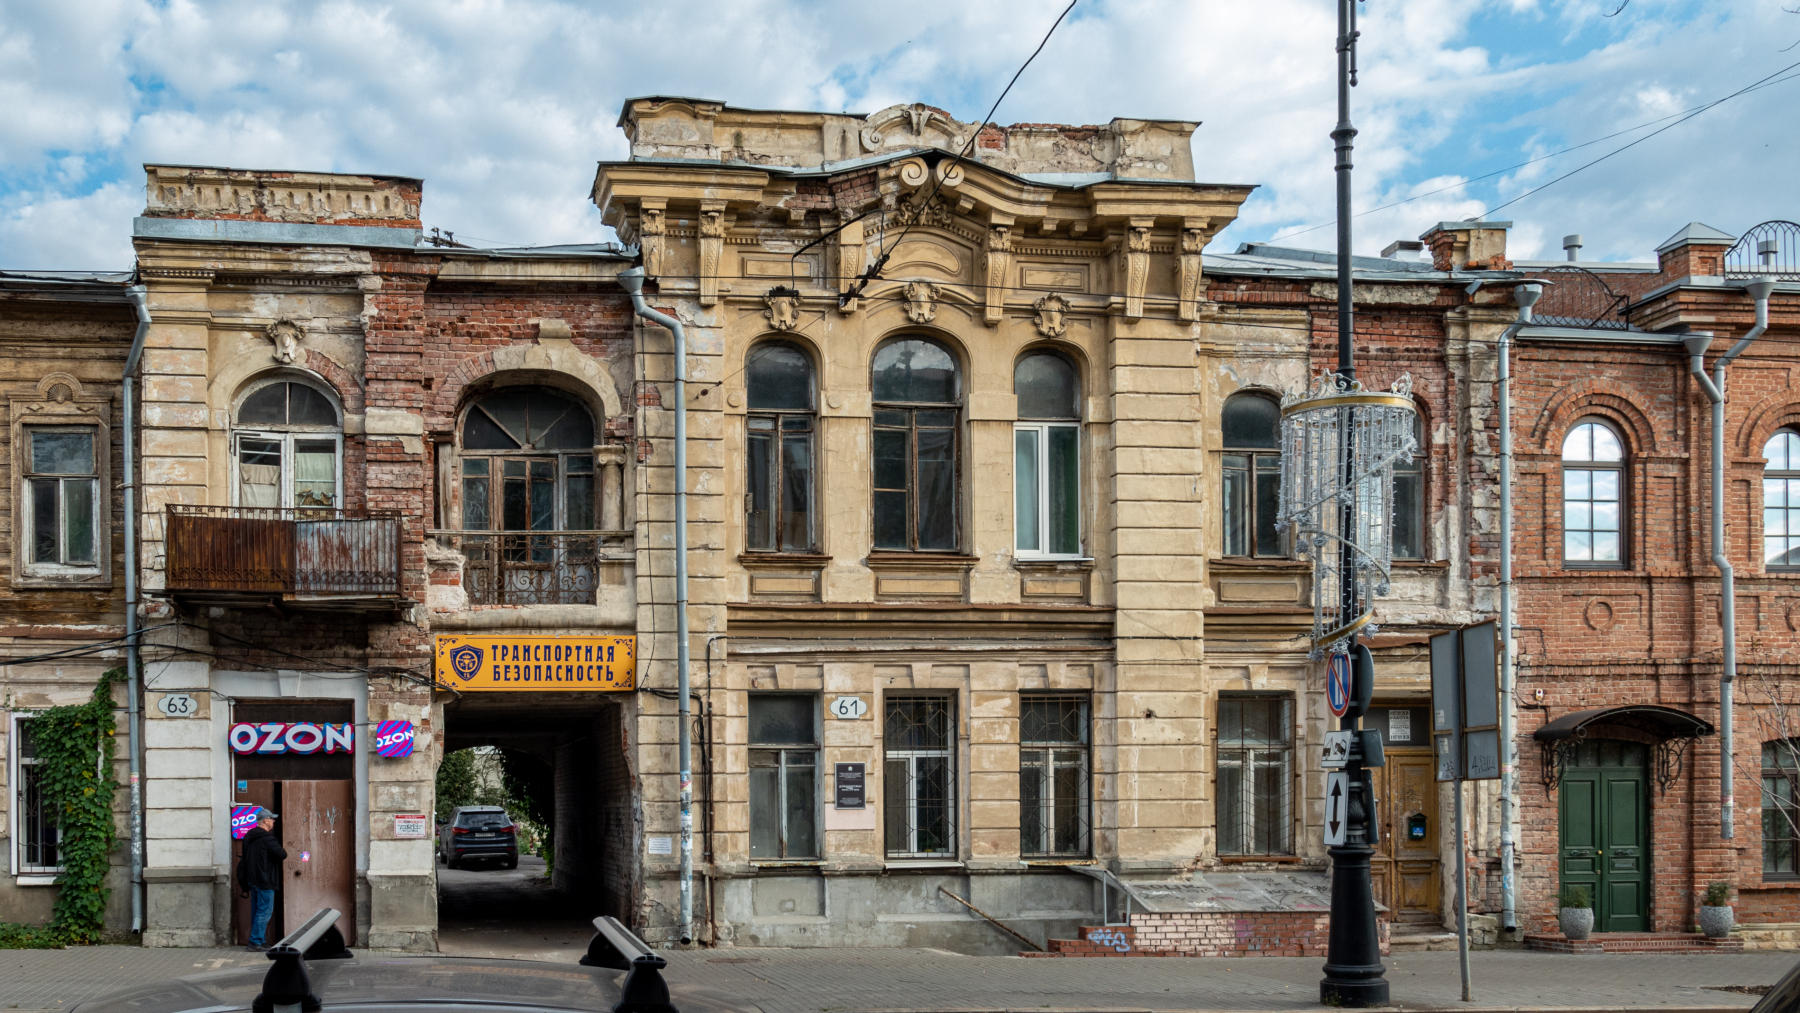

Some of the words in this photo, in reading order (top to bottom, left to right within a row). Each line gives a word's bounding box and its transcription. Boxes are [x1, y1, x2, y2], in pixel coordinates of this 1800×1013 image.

[491, 645, 615, 662] ТРАНСПОРТНАЯ
[493, 665, 614, 681] БЕЗОПАСНОСТЬ
[167, 697, 188, 713] 63
[838, 699, 858, 715] 61
[229, 723, 353, 753] OZON
[377, 729, 413, 748] OZON
[232, 813, 257, 827] OZO
